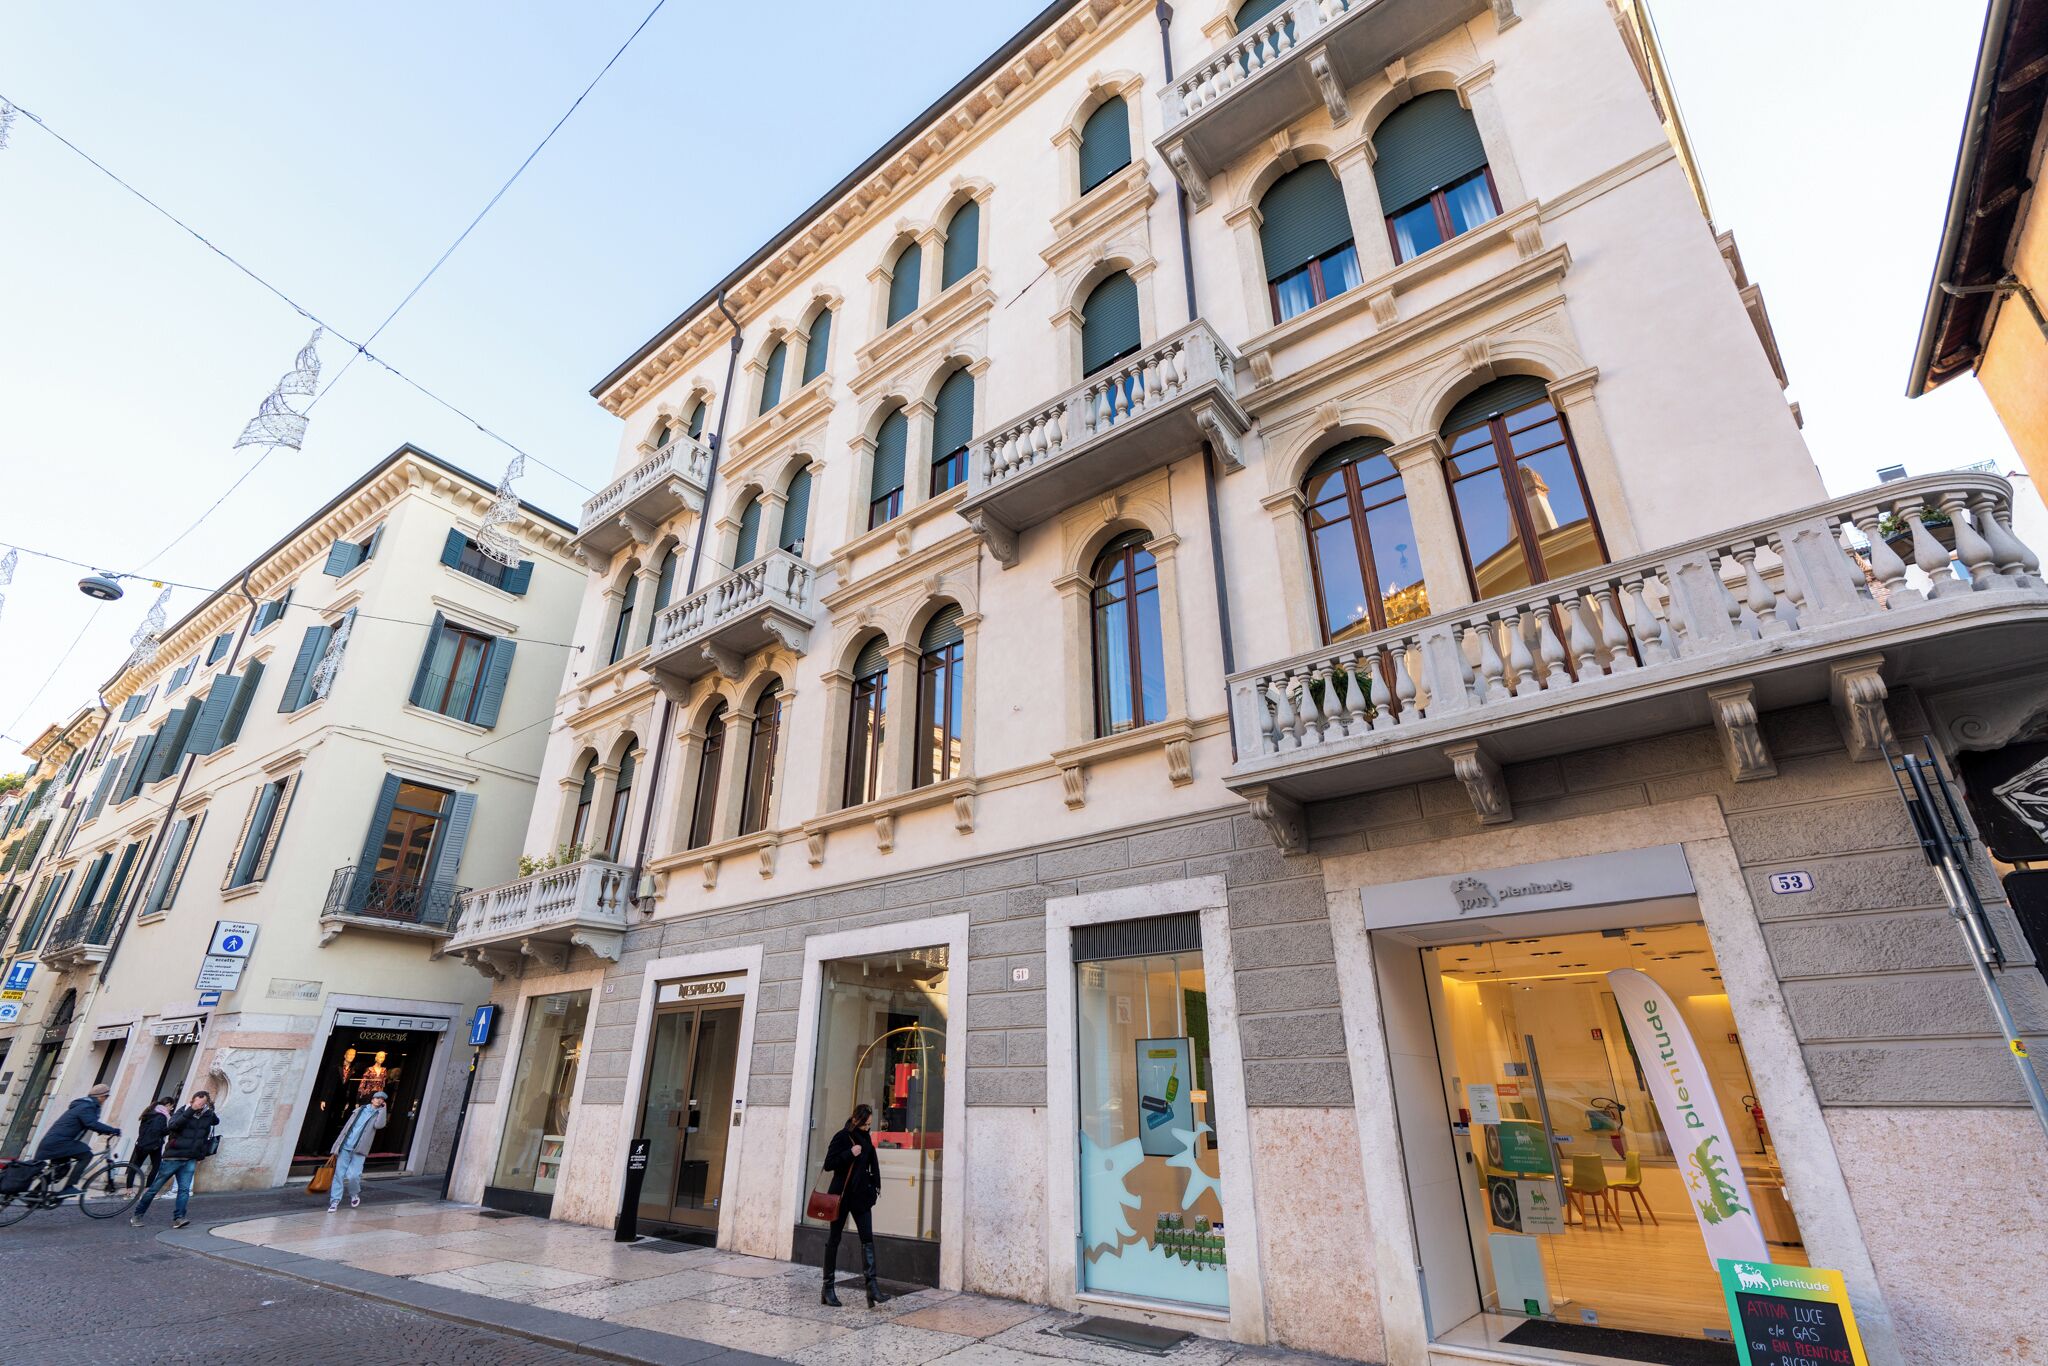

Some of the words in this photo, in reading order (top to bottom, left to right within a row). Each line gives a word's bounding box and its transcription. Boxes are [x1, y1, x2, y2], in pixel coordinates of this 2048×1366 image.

[1498, 880, 1573, 902] plenitude
[1778, 875, 1803, 890] 53
[678, 981, 727, 998] NESPRESSO
[1643, 999, 1705, 1129] plenitude
[1771, 1277, 1831, 1293] plenitude
[1747, 1300, 1790, 1321] ATTIVA
[1794, 1306, 1826, 1326] LUCE
[1792, 1326, 1821, 1342] GAS
[1752, 1341, 1767, 1352] con
[1772, 1339, 1791, 1354] ENI
[1795, 1342, 1851, 1364] PLENITUDE
